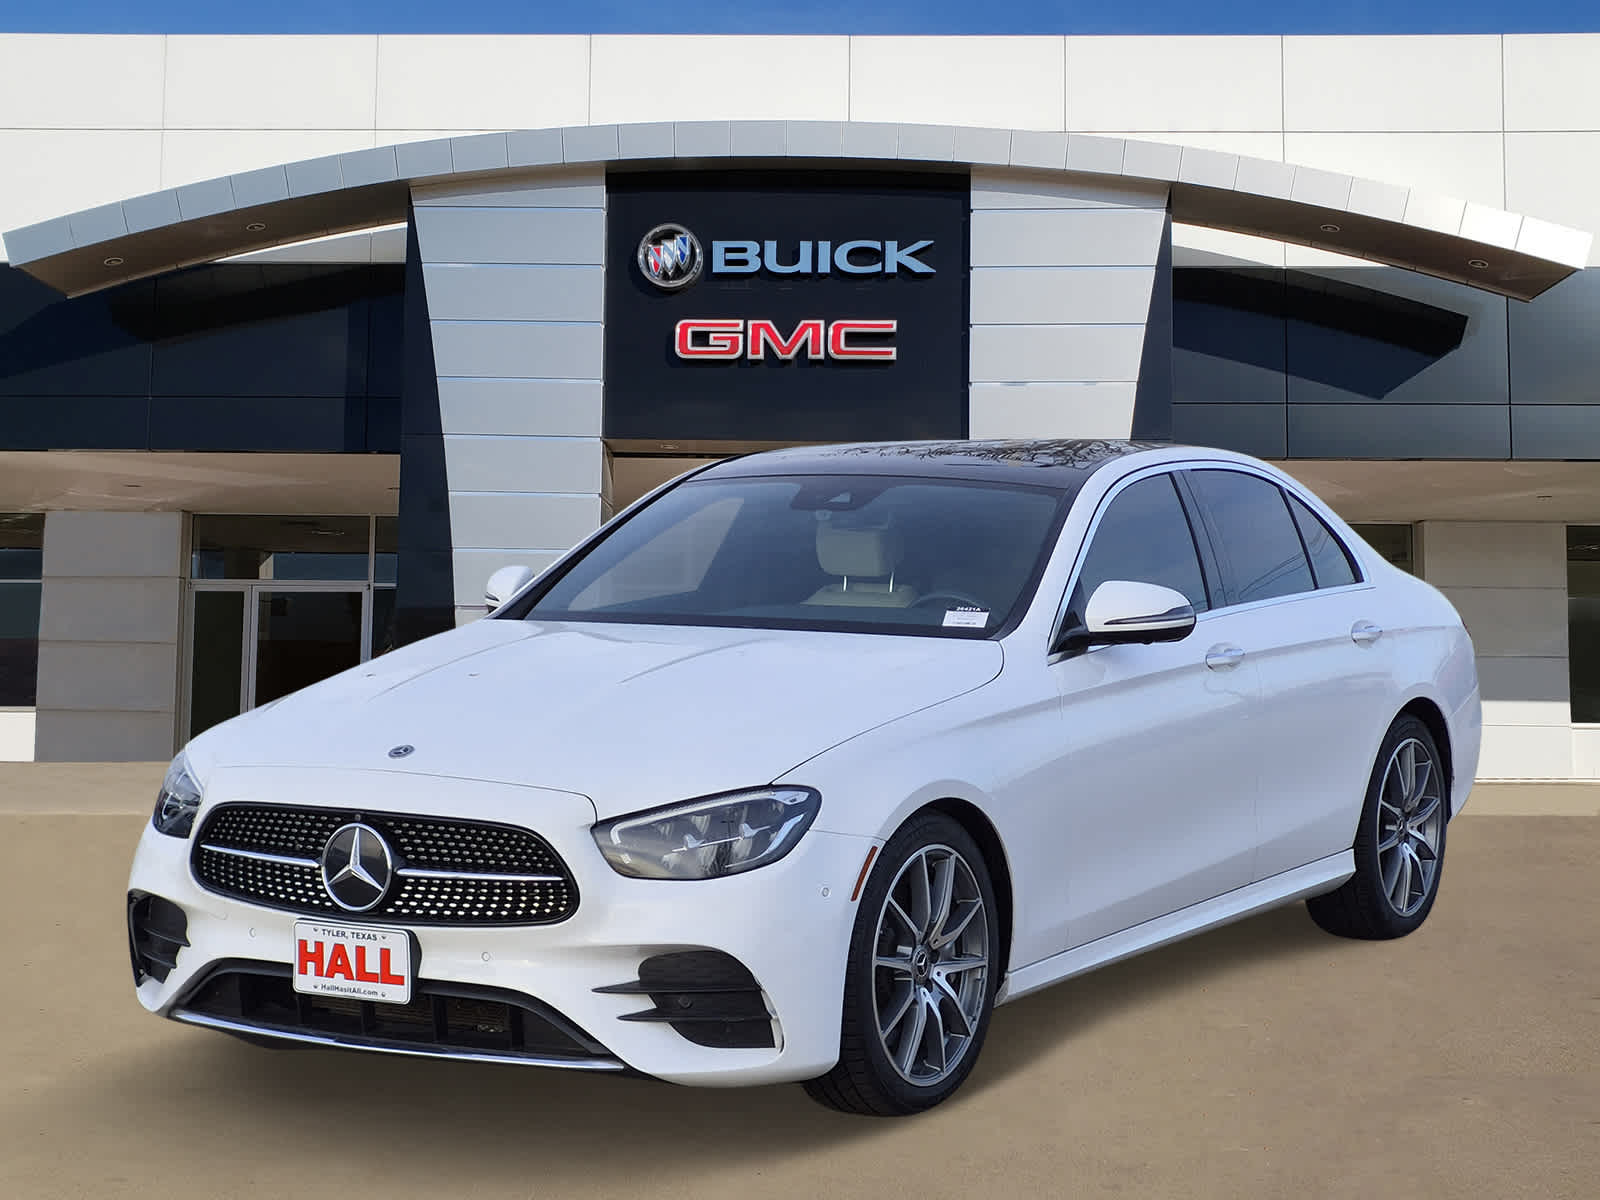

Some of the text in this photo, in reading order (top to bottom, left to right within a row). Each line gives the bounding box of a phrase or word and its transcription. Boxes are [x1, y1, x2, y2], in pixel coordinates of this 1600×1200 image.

[712, 240, 936, 274] BUICK
[675, 319, 897, 360] GMC
[321, 928, 378, 941] TYLER, TEXAS
[298, 939, 405, 986] HALL
